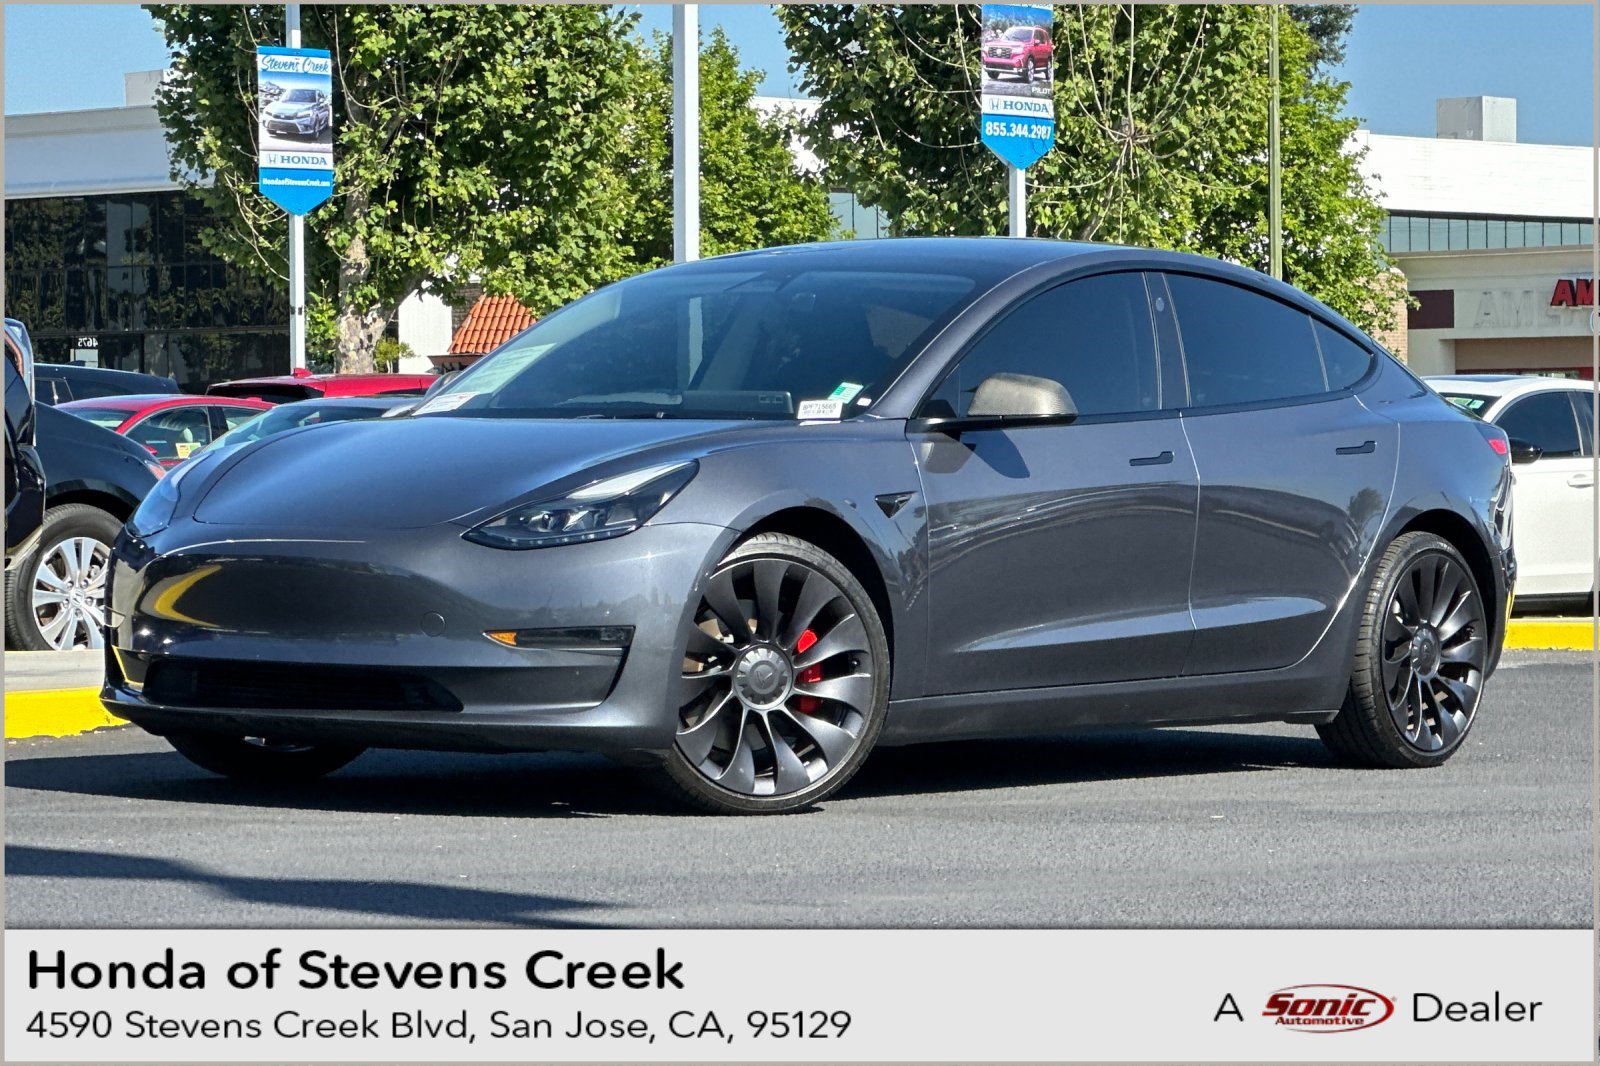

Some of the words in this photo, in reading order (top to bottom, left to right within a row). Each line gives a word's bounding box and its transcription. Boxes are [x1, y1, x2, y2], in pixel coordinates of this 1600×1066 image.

[302, 57, 330, 74] Creek
[1032, 87, 1051, 95] PILOT
[1004, 100, 1049, 113] HONDA
[985, 121, 1052, 140] 855.344.2987
[279, 155, 328, 166] HONDA
